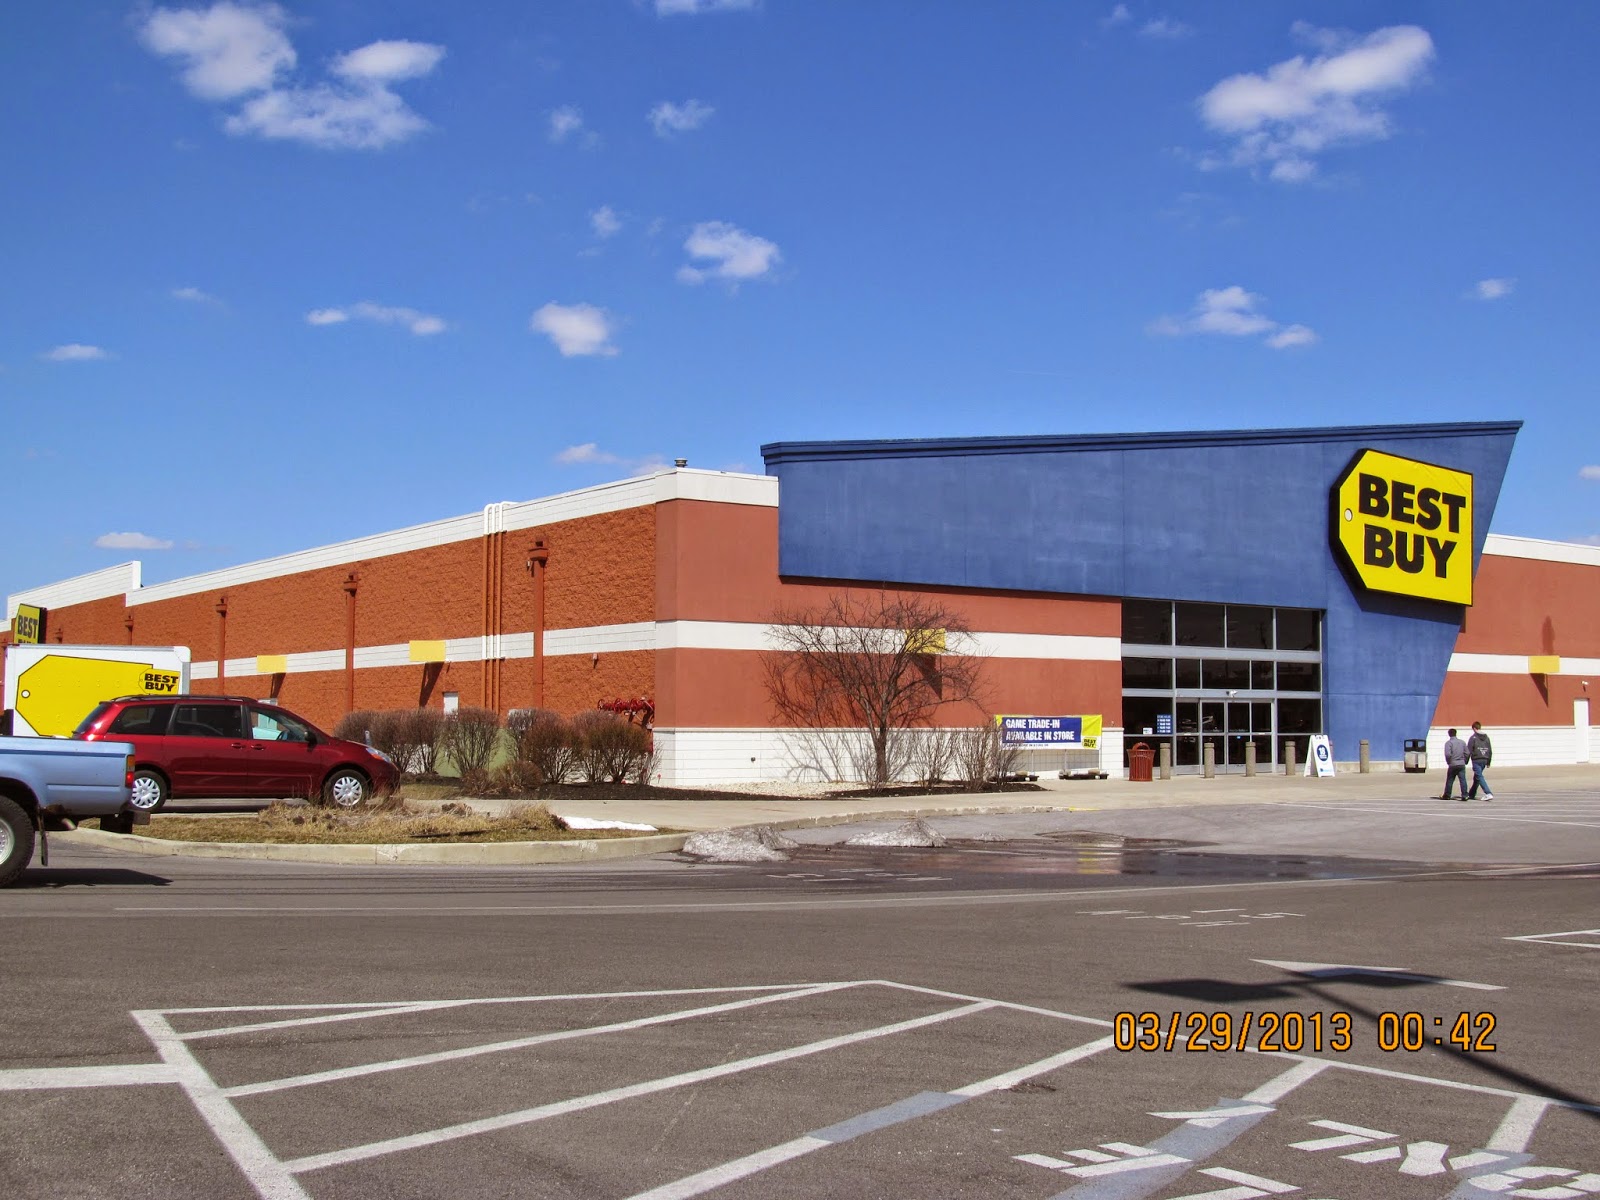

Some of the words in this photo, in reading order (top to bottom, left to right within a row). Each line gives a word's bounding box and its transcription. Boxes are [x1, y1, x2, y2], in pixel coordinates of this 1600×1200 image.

[1359, 472, 1466, 534] BEST
[1364, 523, 1458, 579] BUY
[18, 614, 38, 639] BEST
[144, 673, 179, 684] BEST
[145, 681, 175, 692] BUY
[1005, 719, 1026, 728] GAME
[1028, 719, 1060, 728] TRADE-IN
[1006, 731, 1042, 740] AVAILABLE
[1044, 731, 1052, 740] IN
[1053, 731, 1075, 740] STORE
